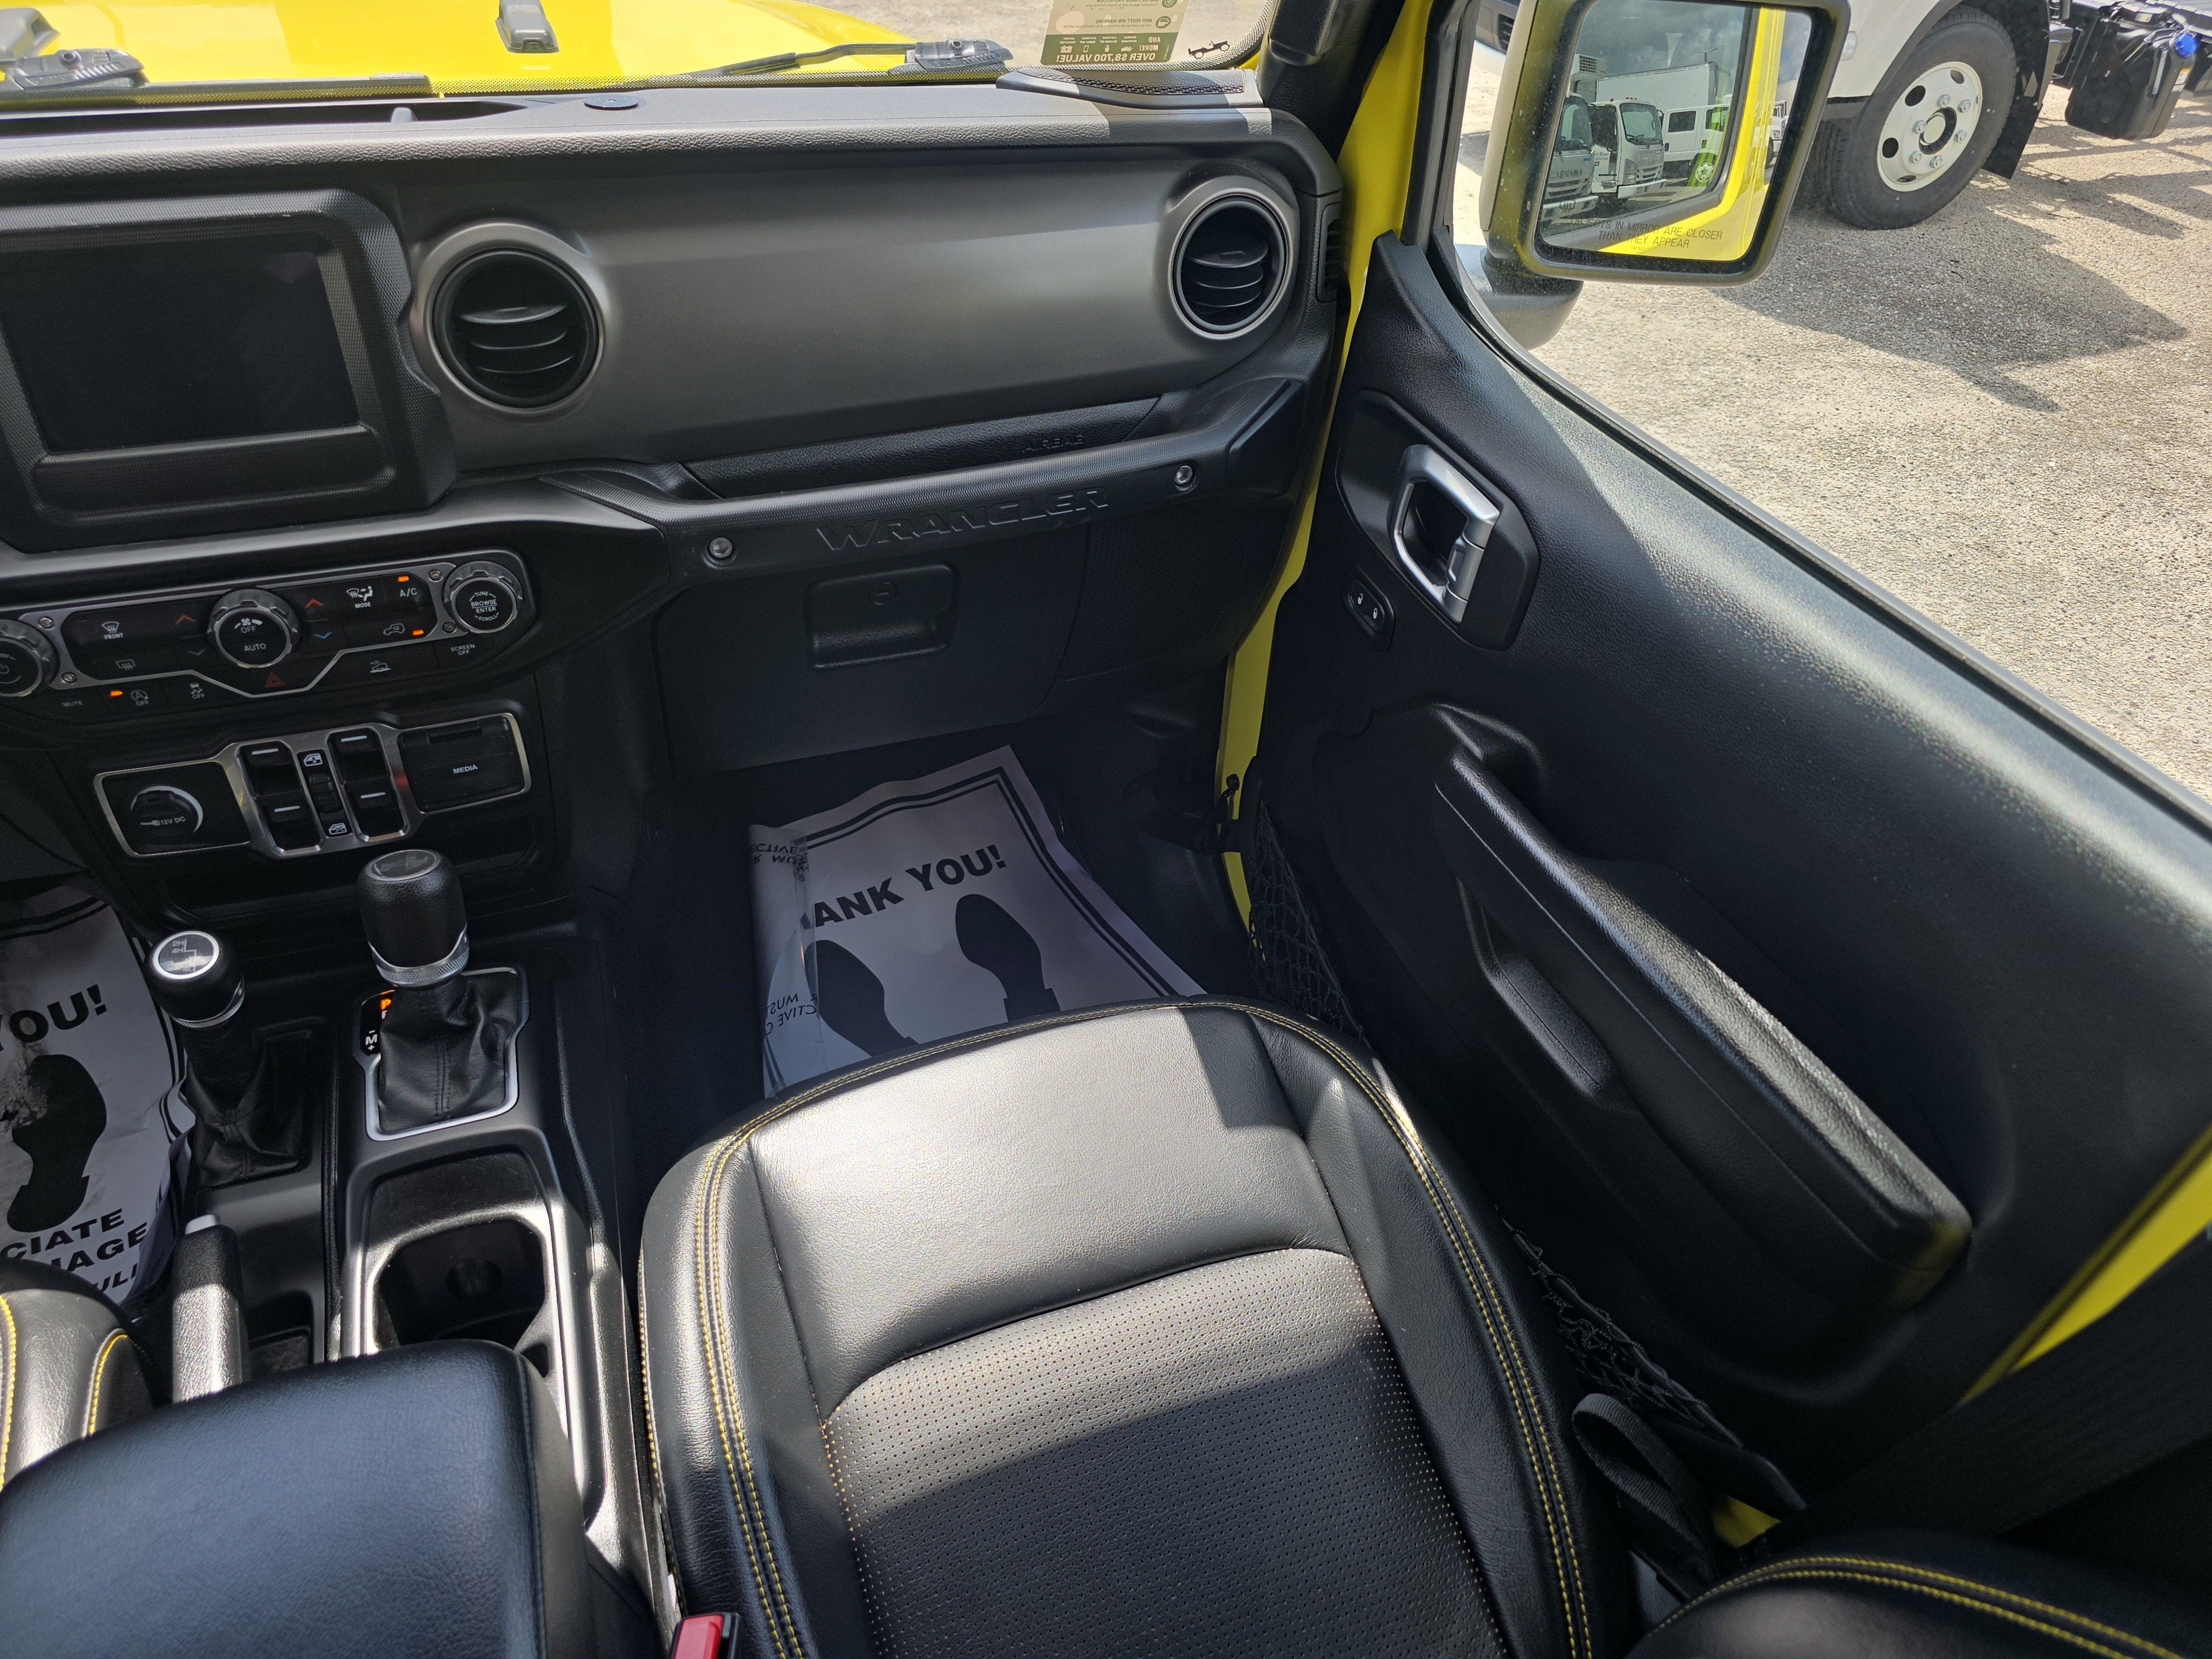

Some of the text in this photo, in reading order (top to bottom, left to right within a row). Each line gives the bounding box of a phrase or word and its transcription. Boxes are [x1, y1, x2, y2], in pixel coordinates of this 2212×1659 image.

[1571, 218, 1722, 240] OBJECTS IN MIRROR ARE CLOSER
[1599, 230, 1622, 240] THAN
[1626, 234, 1649, 244] THEY
[1652, 237, 1689, 248] APPEAR
[816, 486, 1108, 551] WRANGLER
[400, 588, 417, 597] A/C
[471, 599, 497, 607] BROWSE
[240, 625, 257, 634] OFF
[244, 642, 267, 652] AUTO
[451, 644, 475, 652] SCREEN
[453, 764, 478, 774] MEDIA
[814, 844, 1007, 928] ANK YOU!
[381, 998, 391, 1011] P
[0, 983, 107, 1052] OU!
[365, 1033, 378, 1046] M
